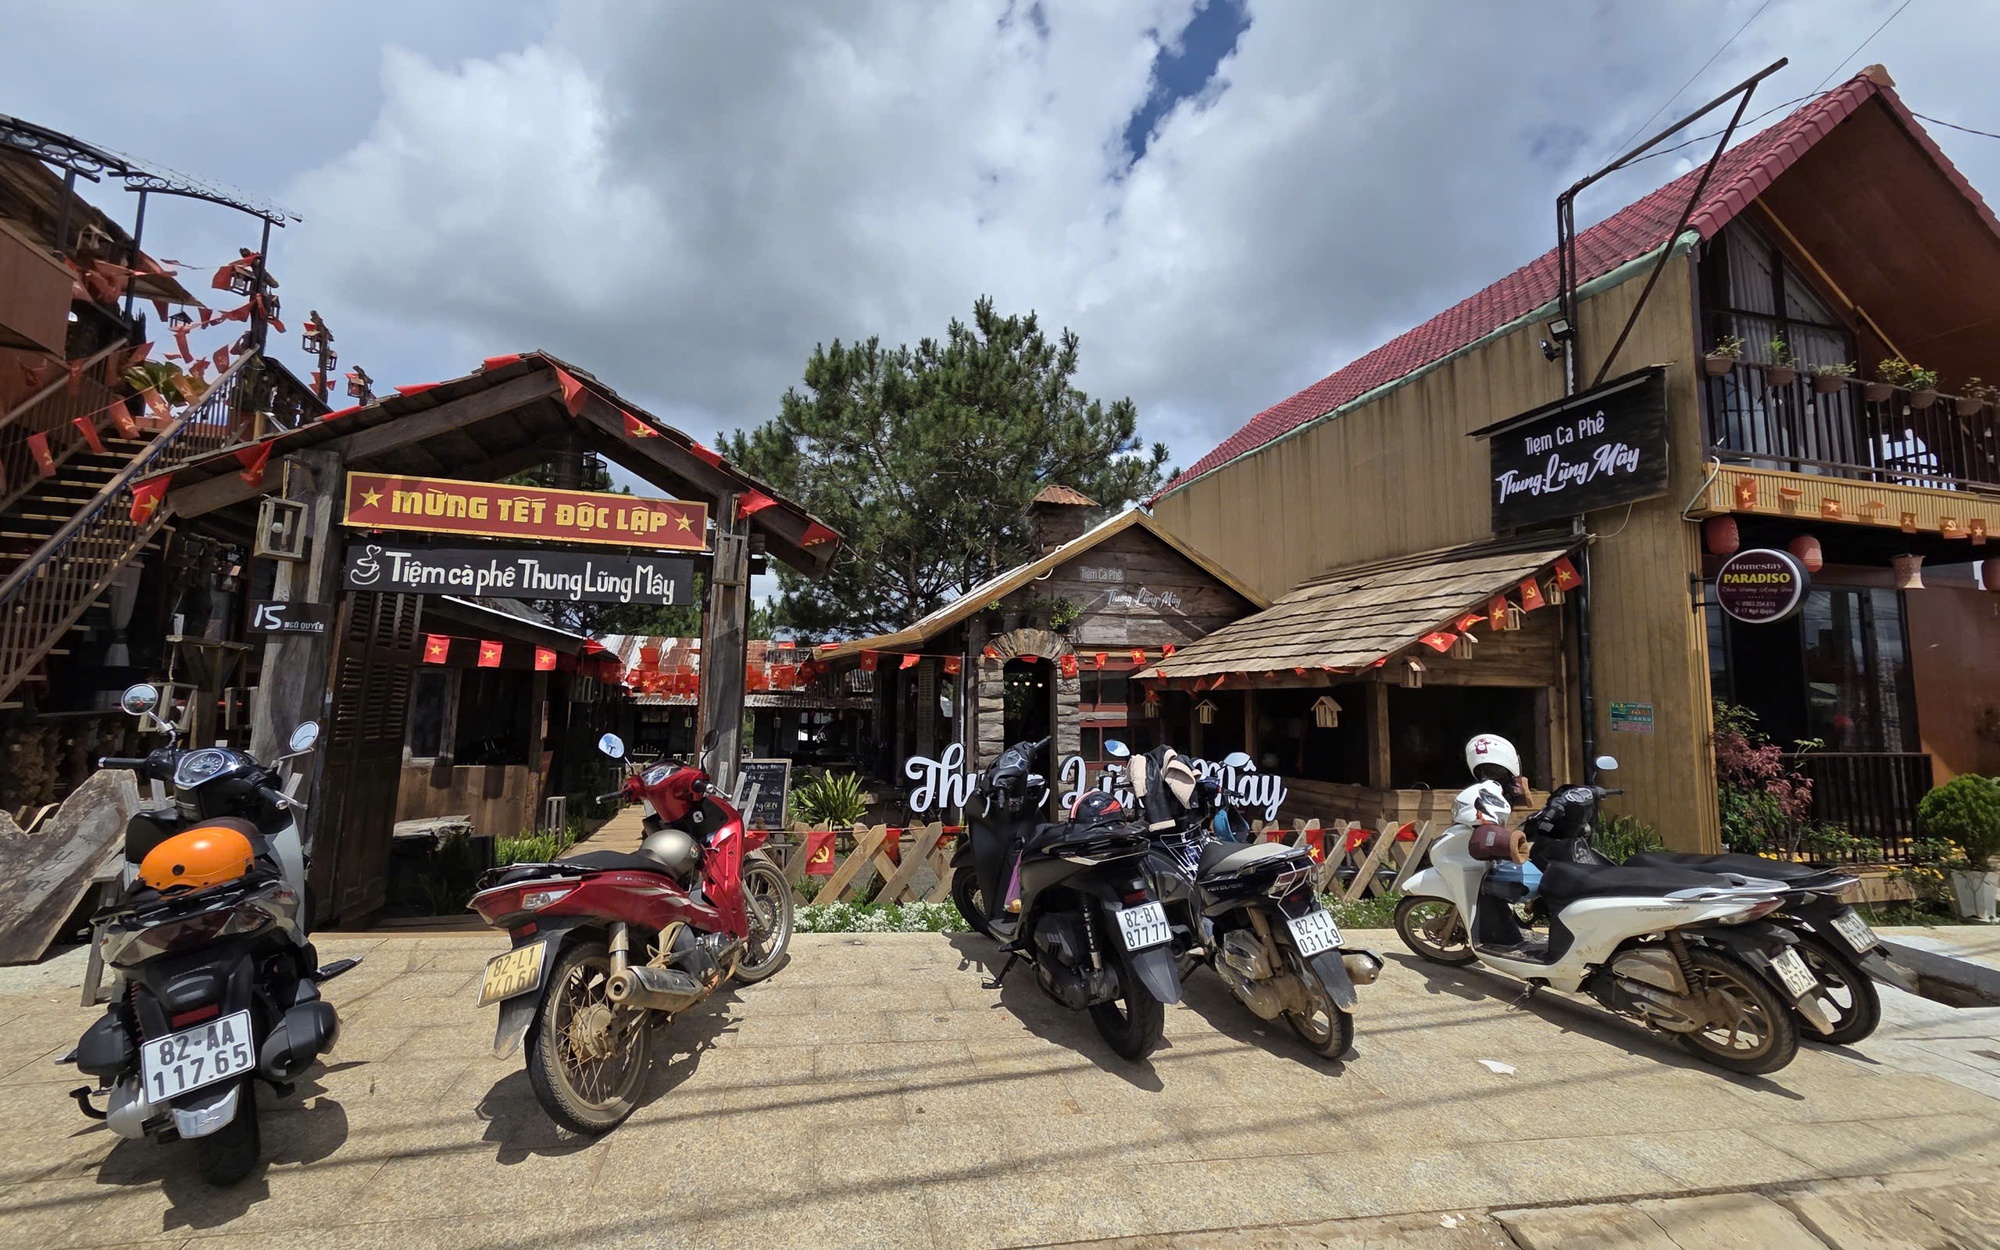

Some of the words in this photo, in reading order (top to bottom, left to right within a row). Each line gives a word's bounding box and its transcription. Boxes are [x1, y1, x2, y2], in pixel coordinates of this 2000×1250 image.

[1578, 409, 1606, 440] Phê
[1494, 469, 1543, 504] Thung
[1542, 453, 1590, 494] Lũng
[1587, 442, 1640, 482] Mây
[391, 487, 489, 520] MỪNG
[497, 496, 547, 524] TẾT
[554, 501, 610, 532] ĐỘC
[616, 506, 668, 535] LẬP
[385, 551, 446, 587] Tiệm
[448, 563, 474, 586] cà
[475, 559, 516, 596] phê
[517, 558, 583, 601] Thung
[584, 561, 633, 603] Lũng
[634, 564, 675, 606] Mây
[1723, 572, 1791, 584] PARADISO
[1731, 563, 1784, 571] Homestay
[1104, 588, 1133, 607] Thung
[1159, 591, 1182, 608] Mây
[254, 603, 287, 630] 15
[1124, 905, 1159, 928] 82-B1
[1295, 913, 1329, 936] 82-L1
[1126, 921, 1167, 948] 877.77
[1299, 928, 1341, 954] 031.49
[493, 946, 536, 978] 82-L1
[159, 1020, 235, 1066] 82-AA
[153, 1042, 249, 1097] 117.65
